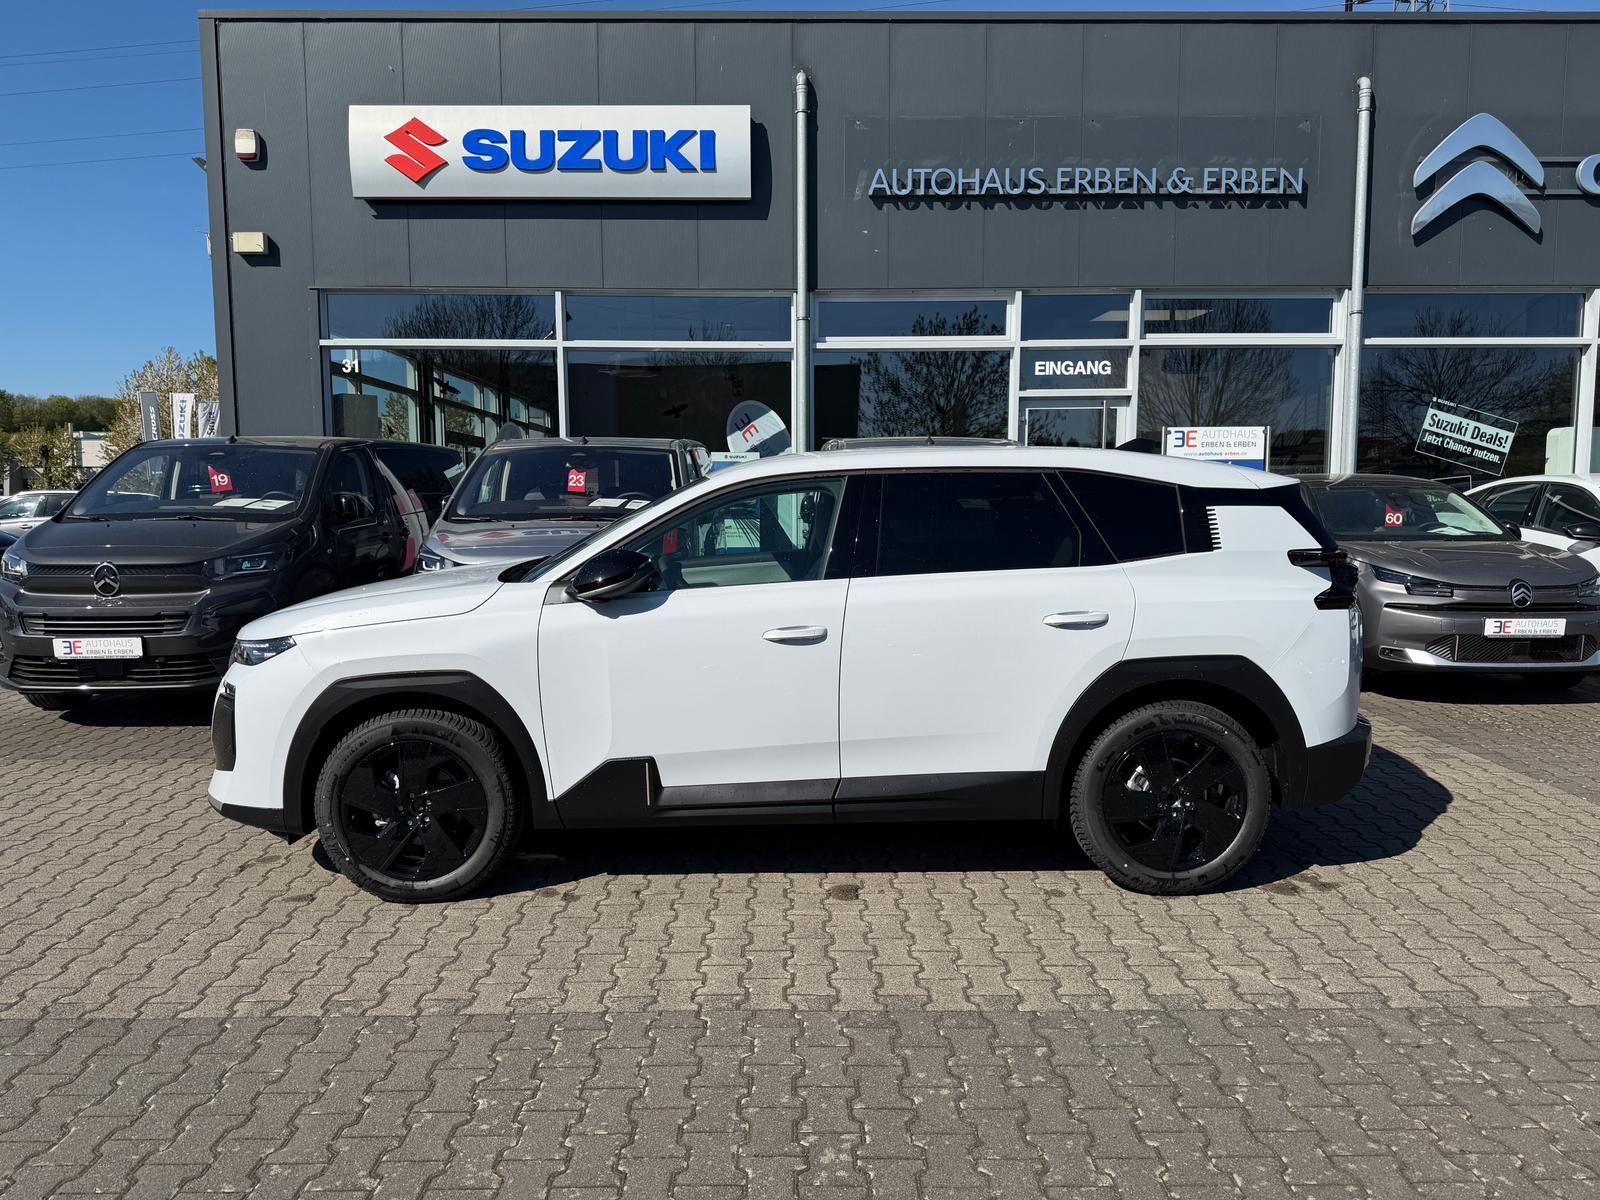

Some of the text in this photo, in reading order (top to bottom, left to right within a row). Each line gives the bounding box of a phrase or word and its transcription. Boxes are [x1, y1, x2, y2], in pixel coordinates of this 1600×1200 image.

[462, 129, 716, 171] SUZUKI
[868, 167, 1304, 195] AUTOHAUS ERBEN & ERBEN
[342, 359, 359, 373] 31
[1035, 361, 1111, 375] EINGANG
[1202, 429, 1257, 439] AUTOHAUS
[1428, 413, 1509, 449] Suzuki Deals!
[1423, 432, 1501, 463] Jetzt Chance nutzen.
[211, 474, 229, 487] 19
[568, 474, 585, 487] 23
[1385, 512, 1402, 525] 60
[1515, 620, 1558, 628] AUTOHAUS
[86, 640, 134, 648] AUTOHAUS
